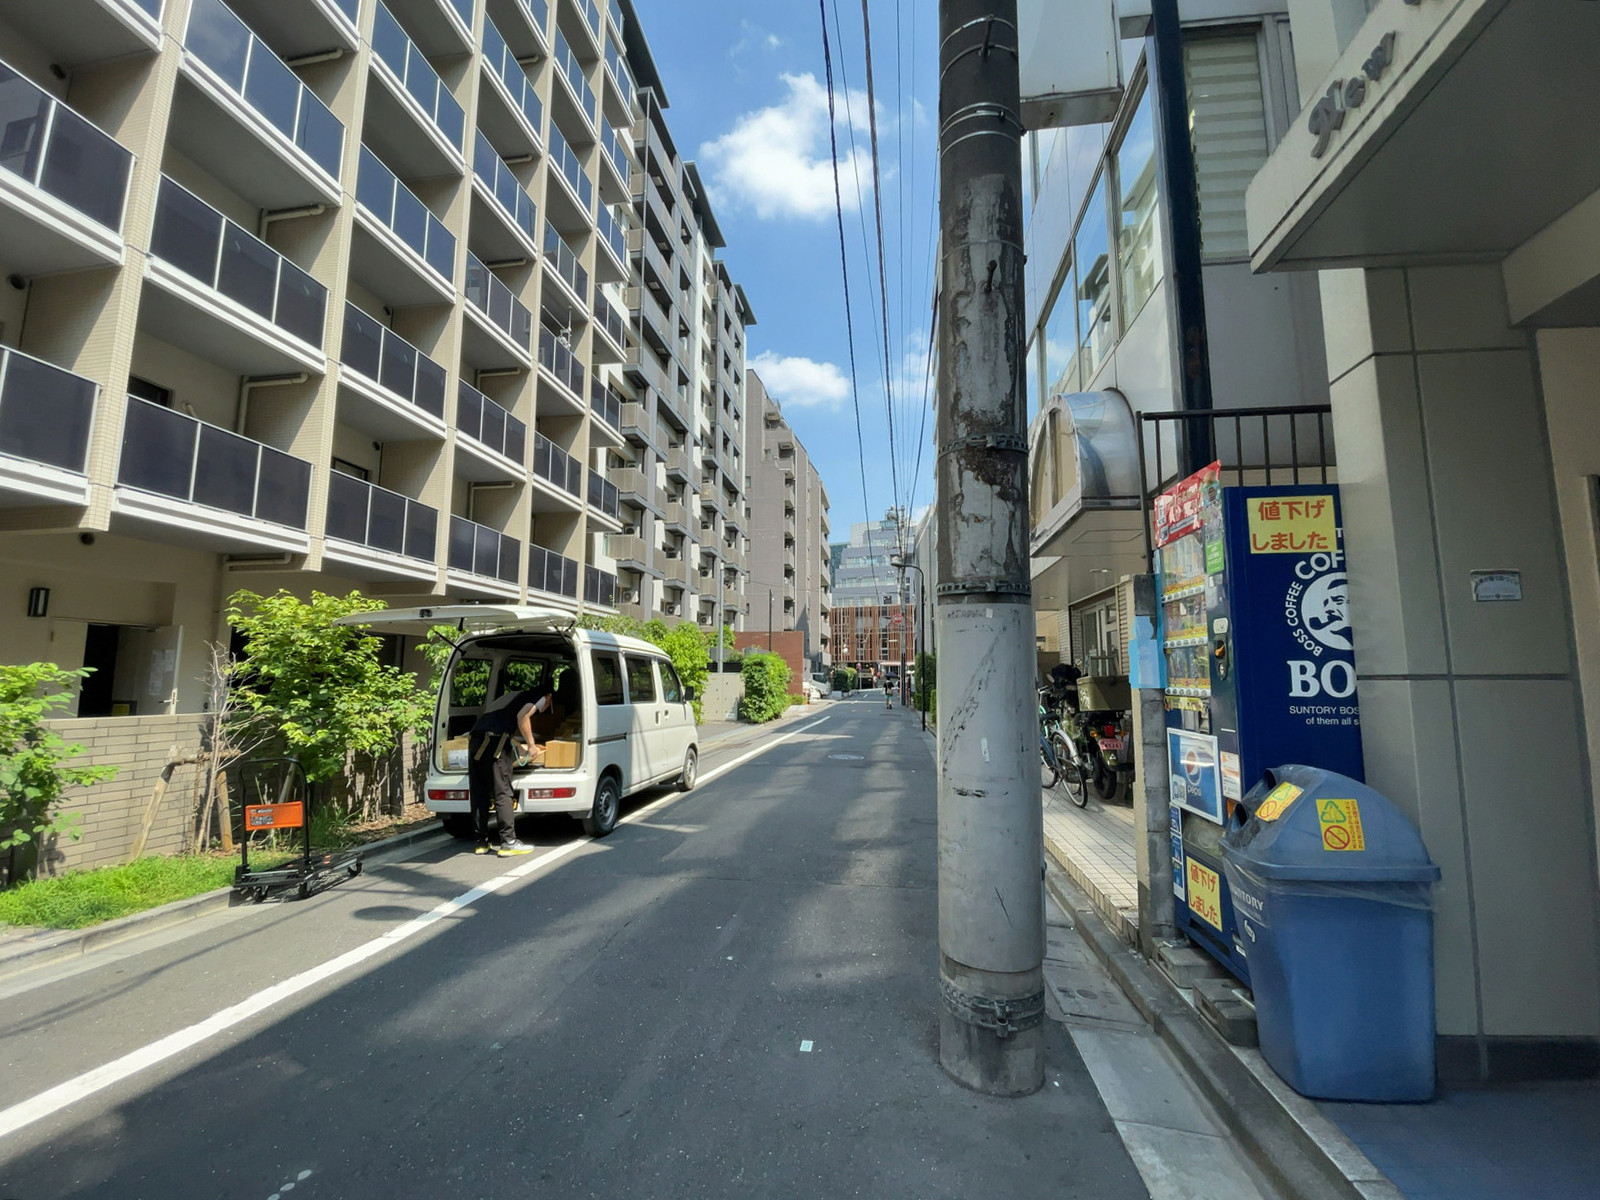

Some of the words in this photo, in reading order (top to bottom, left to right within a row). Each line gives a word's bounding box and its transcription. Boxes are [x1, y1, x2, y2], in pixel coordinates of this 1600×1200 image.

[1258, 498, 1326, 521] 値下げ
[1252, 531, 1329, 551] しました
[1285, 581, 1303, 626] COFFEE
[1292, 629, 1323, 657] BOSS
[1289, 705, 1336, 714] SUNTORY
[1305, 717, 1314, 725] of
[1316, 717, 1339, 725] them
[1341, 717, 1351, 725] all
[1190, 864, 1216, 893] 値下げ
[1188, 892, 1219, 926] しました
